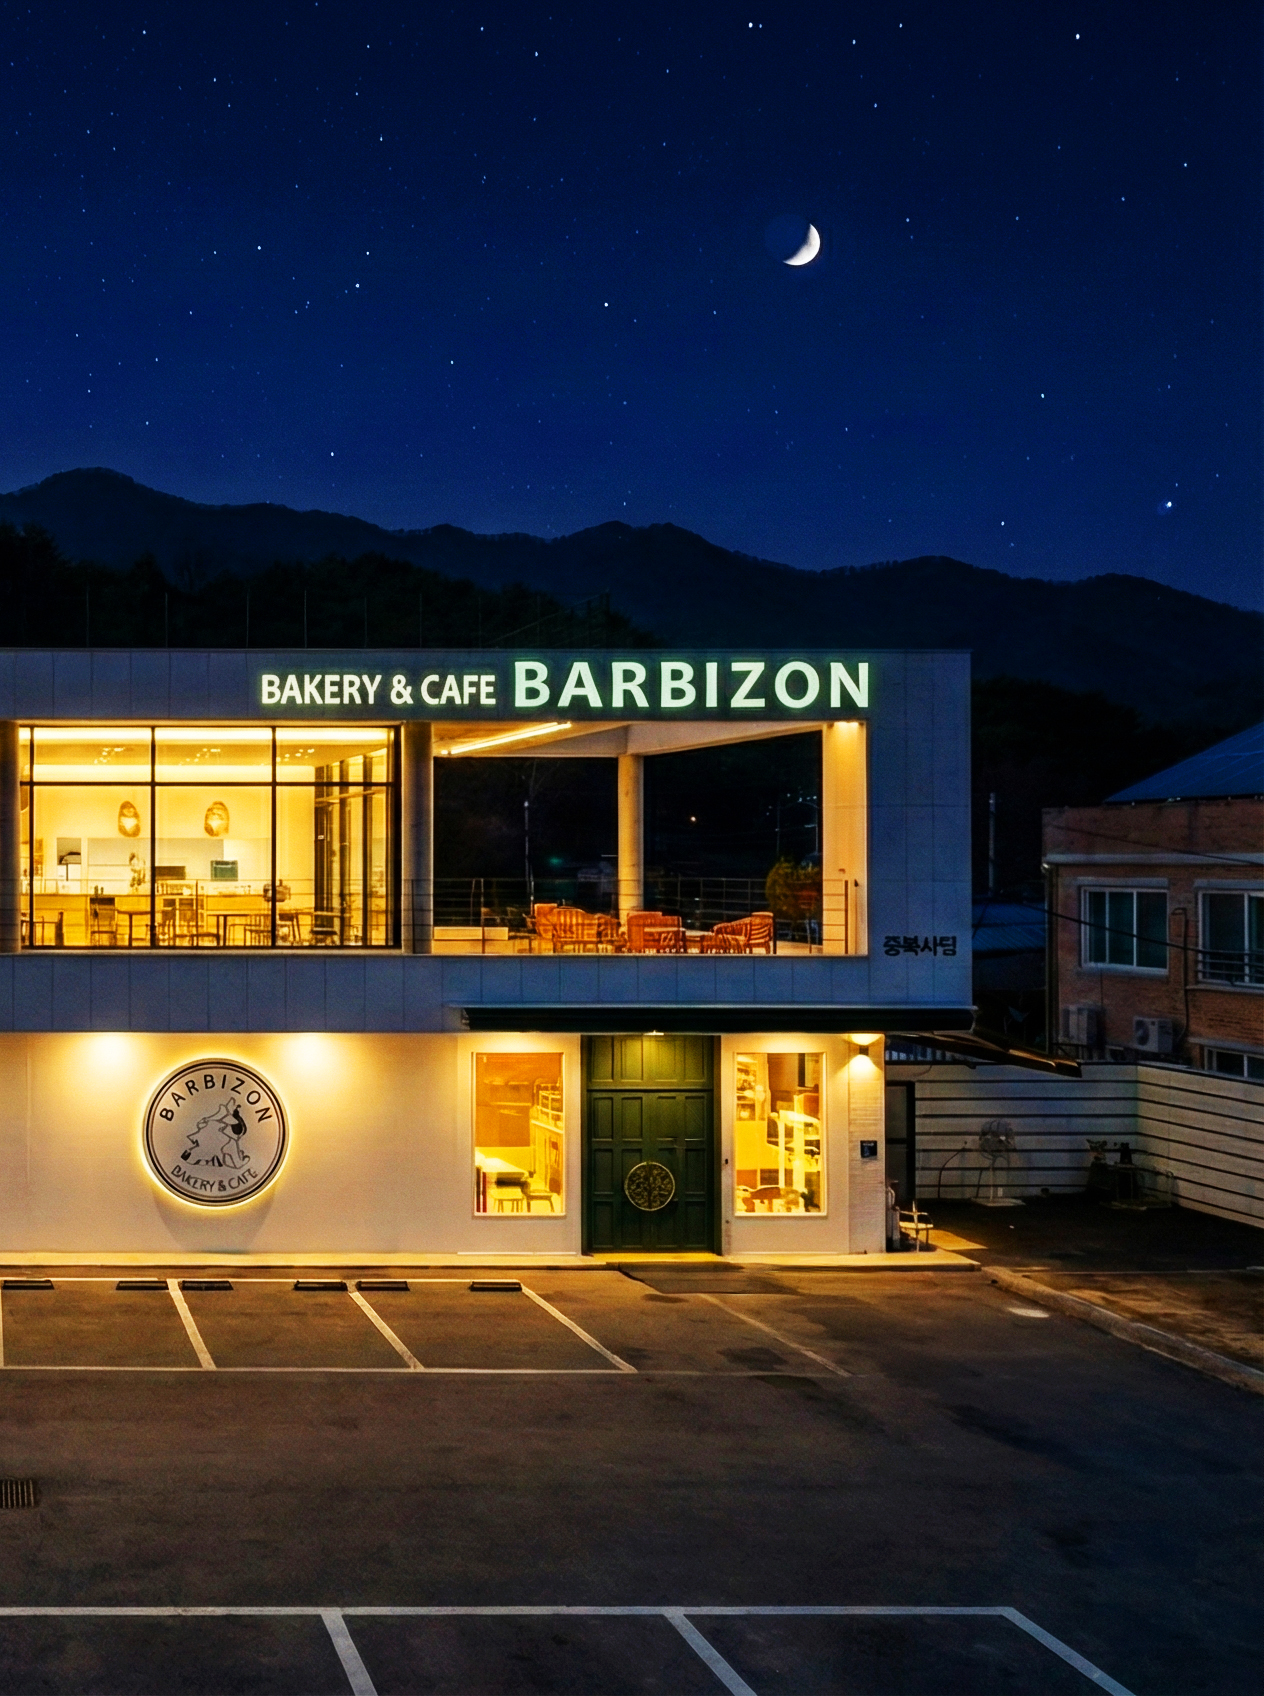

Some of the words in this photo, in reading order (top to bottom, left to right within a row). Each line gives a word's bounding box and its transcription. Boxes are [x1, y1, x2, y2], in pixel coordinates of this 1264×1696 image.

[261, 674, 382, 705] BAKERY
[390, 674, 414, 705] &
[420, 674, 497, 706] CAFE
[514, 661, 869, 709] BARBIZON
[159, 1074, 273, 1123] BARBIZON
[171, 1164, 216, 1192] BAKERY
